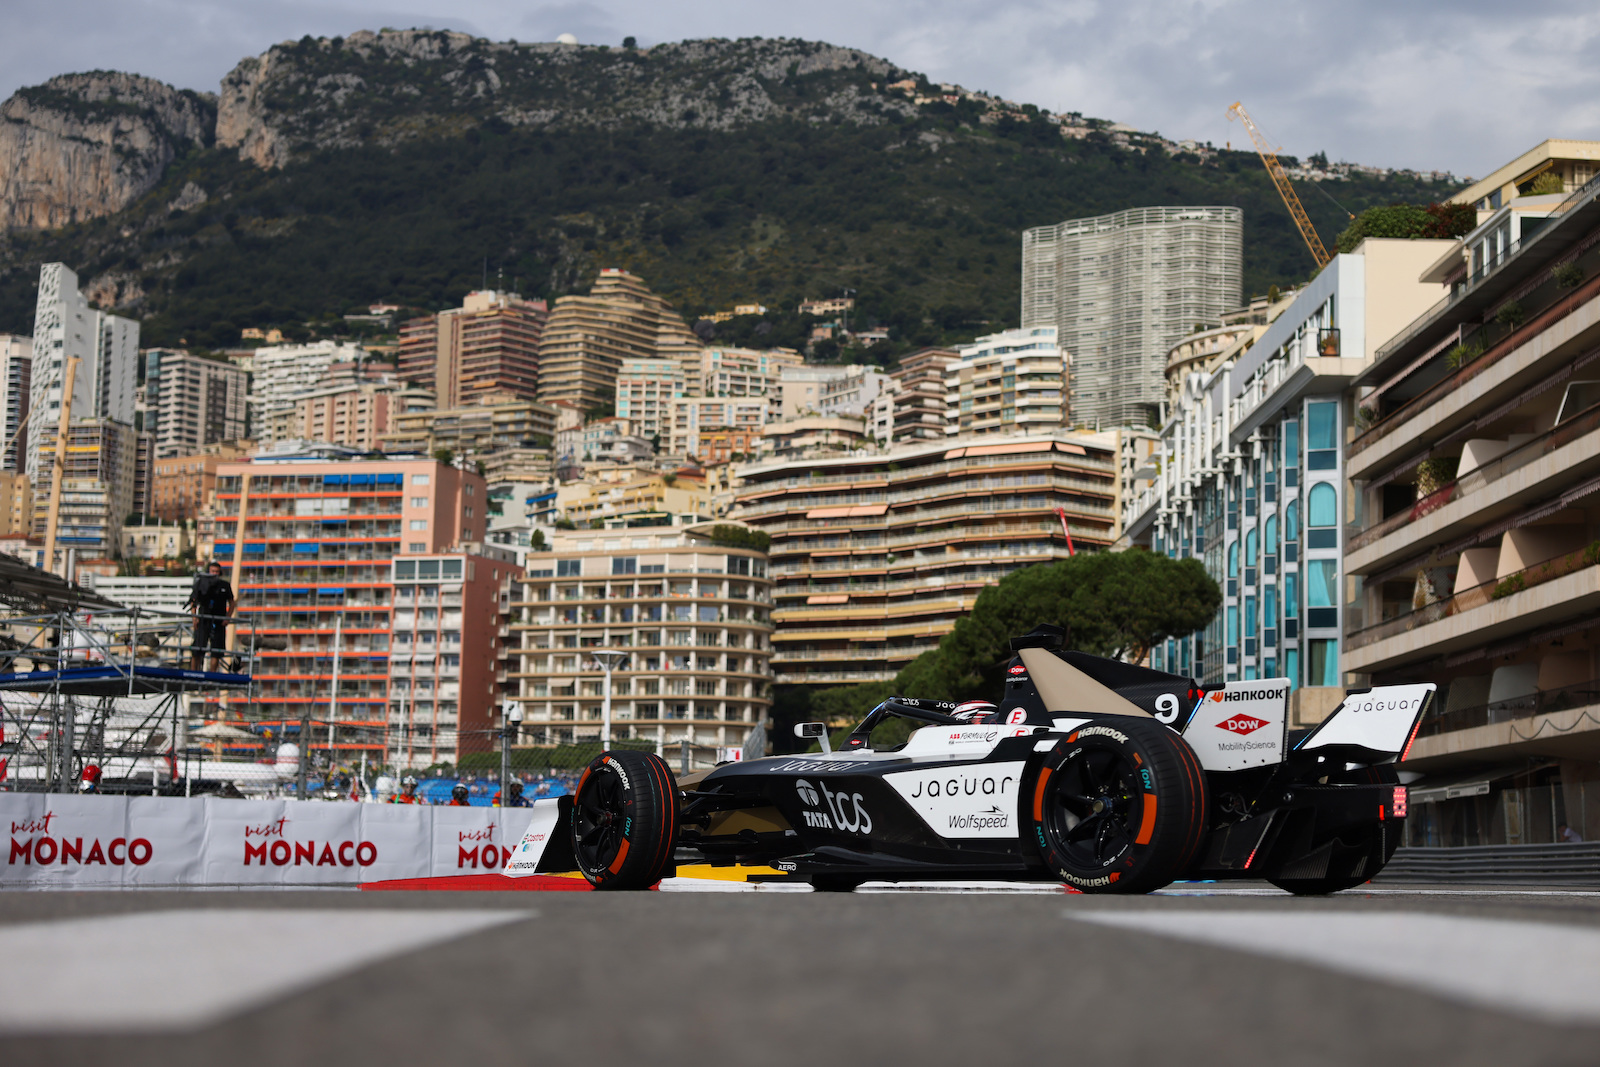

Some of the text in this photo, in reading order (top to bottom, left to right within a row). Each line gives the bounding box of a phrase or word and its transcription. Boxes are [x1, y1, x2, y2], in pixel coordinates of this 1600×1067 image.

[1010, 711, 1022, 725] E
[1154, 693, 1180, 724] 9
[1227, 719, 1260, 730] DOW
[1218, 741, 1276, 752] MobilityScience
[820, 780, 872, 834] tcs
[11, 811, 58, 834] visit
[245, 816, 291, 837] visit
[803, 811, 833, 829] TATA
[949, 814, 1009, 831] Wolfspeed
[458, 822, 497, 842] visit
[8, 837, 153, 866] MONACO
[243, 840, 378, 867] MONACO
[457, 844, 517, 869] MON
